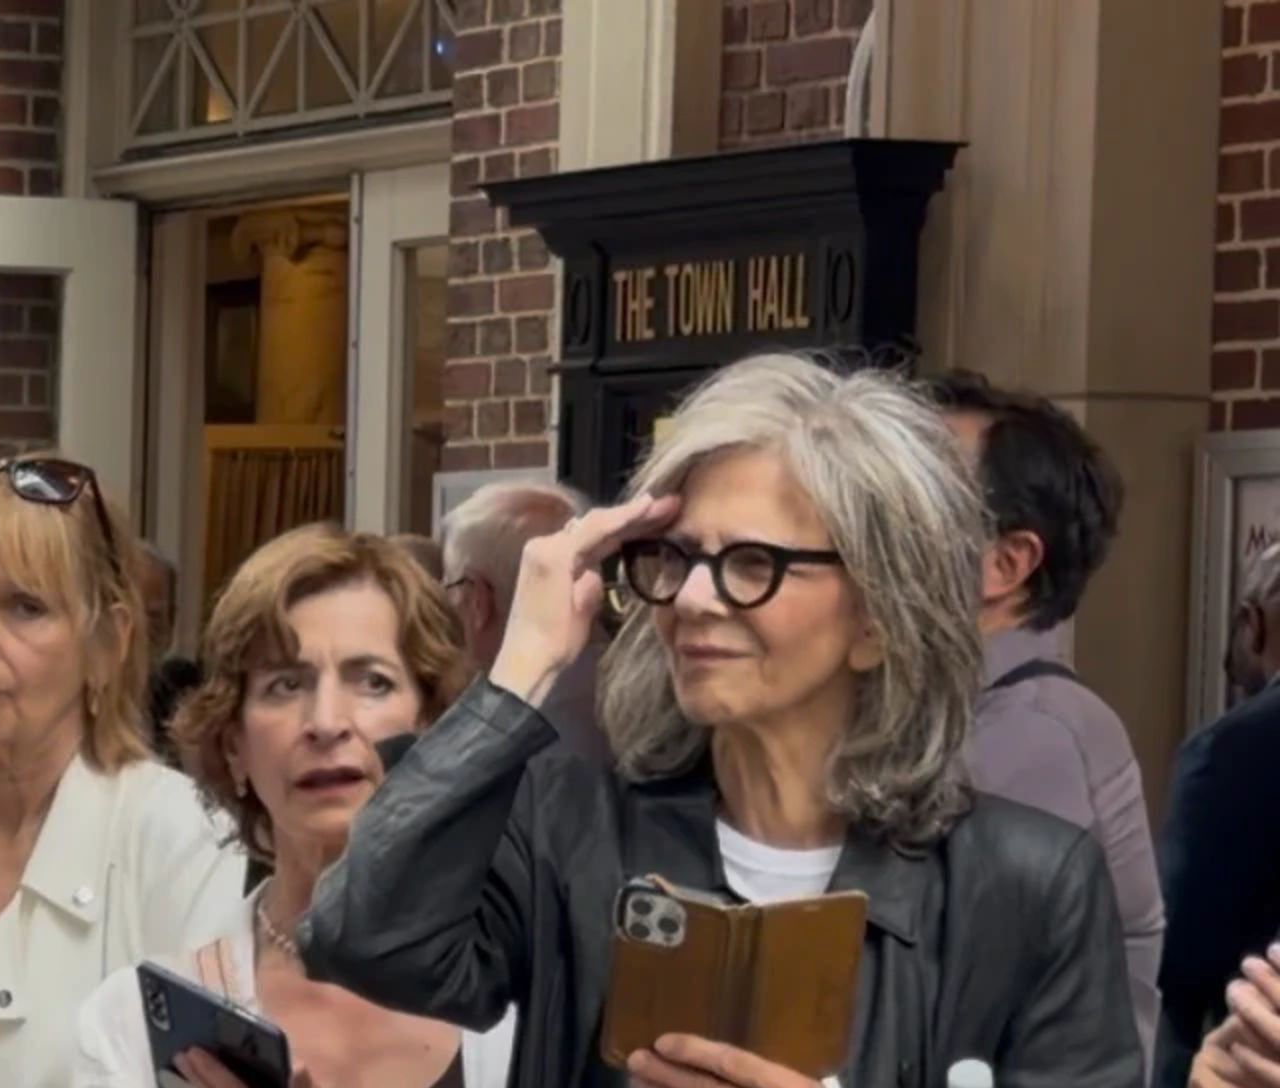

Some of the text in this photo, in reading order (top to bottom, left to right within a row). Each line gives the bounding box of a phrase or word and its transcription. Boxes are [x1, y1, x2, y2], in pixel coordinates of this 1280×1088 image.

[613, 254, 811, 342] THE TOWN HALL
